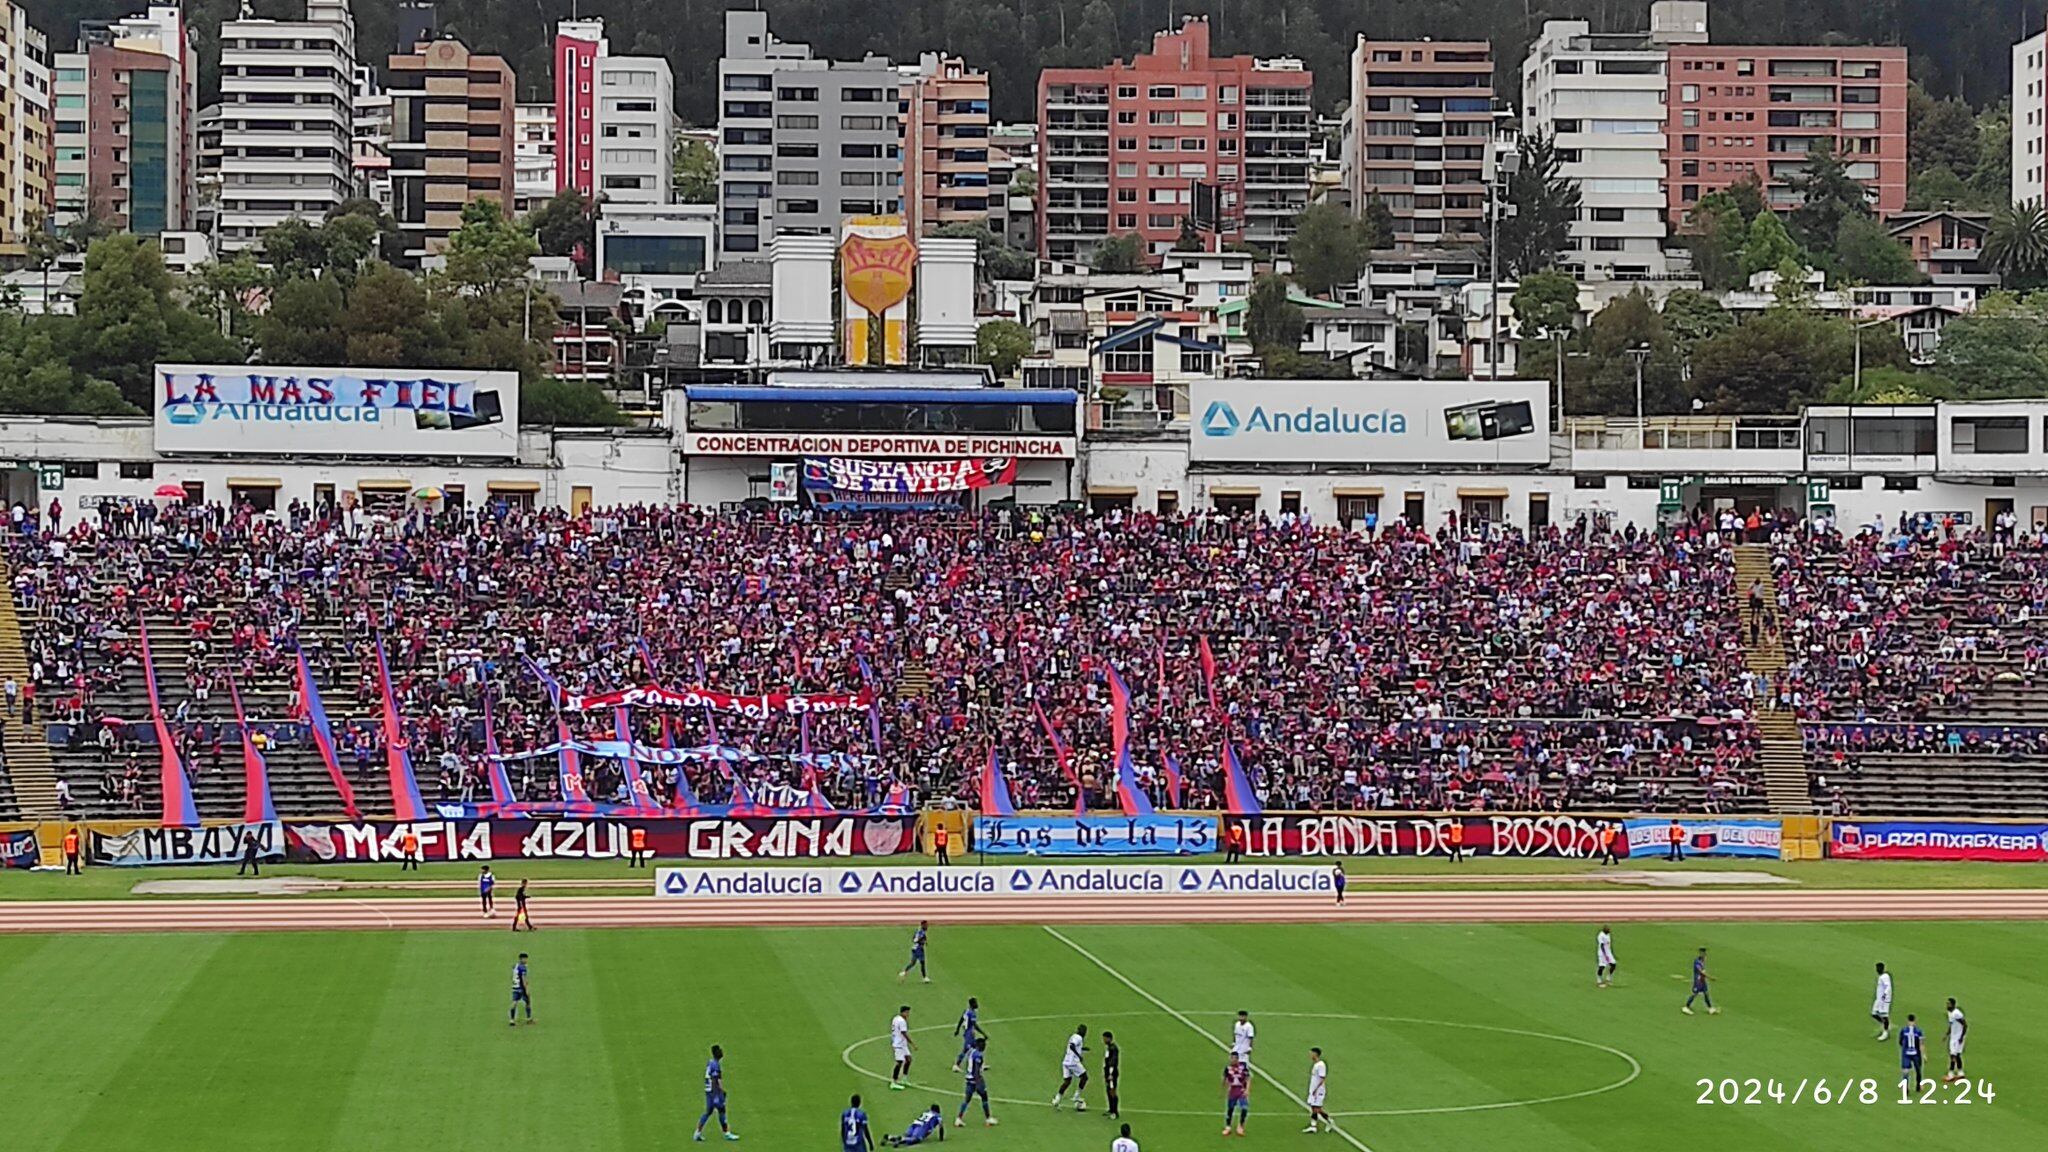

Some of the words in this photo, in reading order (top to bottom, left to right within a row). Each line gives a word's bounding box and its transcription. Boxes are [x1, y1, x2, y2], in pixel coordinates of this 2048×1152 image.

[161, 373, 222, 409] LA
[360, 378, 478, 418] FIEL
[1245, 405, 1407, 434] Andalucía
[696, 437, 844, 452] CONCENTRACION
[849, 438, 941, 454] DEPORTIVA
[944, 440, 968, 454] DE
[972, 440, 1064, 456] PICHINCHA
[828, 457, 976, 478] SUSTANCIA
[43, 472, 62, 487] 13
[832, 474, 863, 490] DE
[868, 478, 900, 492] MI
[903, 474, 970, 493] VIDA
[1664, 485, 1678, 499] 11
[1812, 485, 1827, 499] 11
[335, 820, 493, 863] MAFIA
[521, 820, 656, 859] AZUL
[688, 818, 855, 859] GRANA
[983, 819, 1052, 849] Los
[1075, 819, 1109, 848] de
[1127, 818, 1157, 847] la
[1174, 819, 1208, 848] 13
[1240, 816, 1286, 857] LA
[1296, 815, 1399, 857] BANDA
[1864, 832, 1928, 848] PLAZA
[693, 872, 822, 894] Andalucía
[868, 871, 994, 893] Andalucía
[1038, 869, 1163, 890] Andalucía
[1207, 869, 1331, 890] Andalucía
